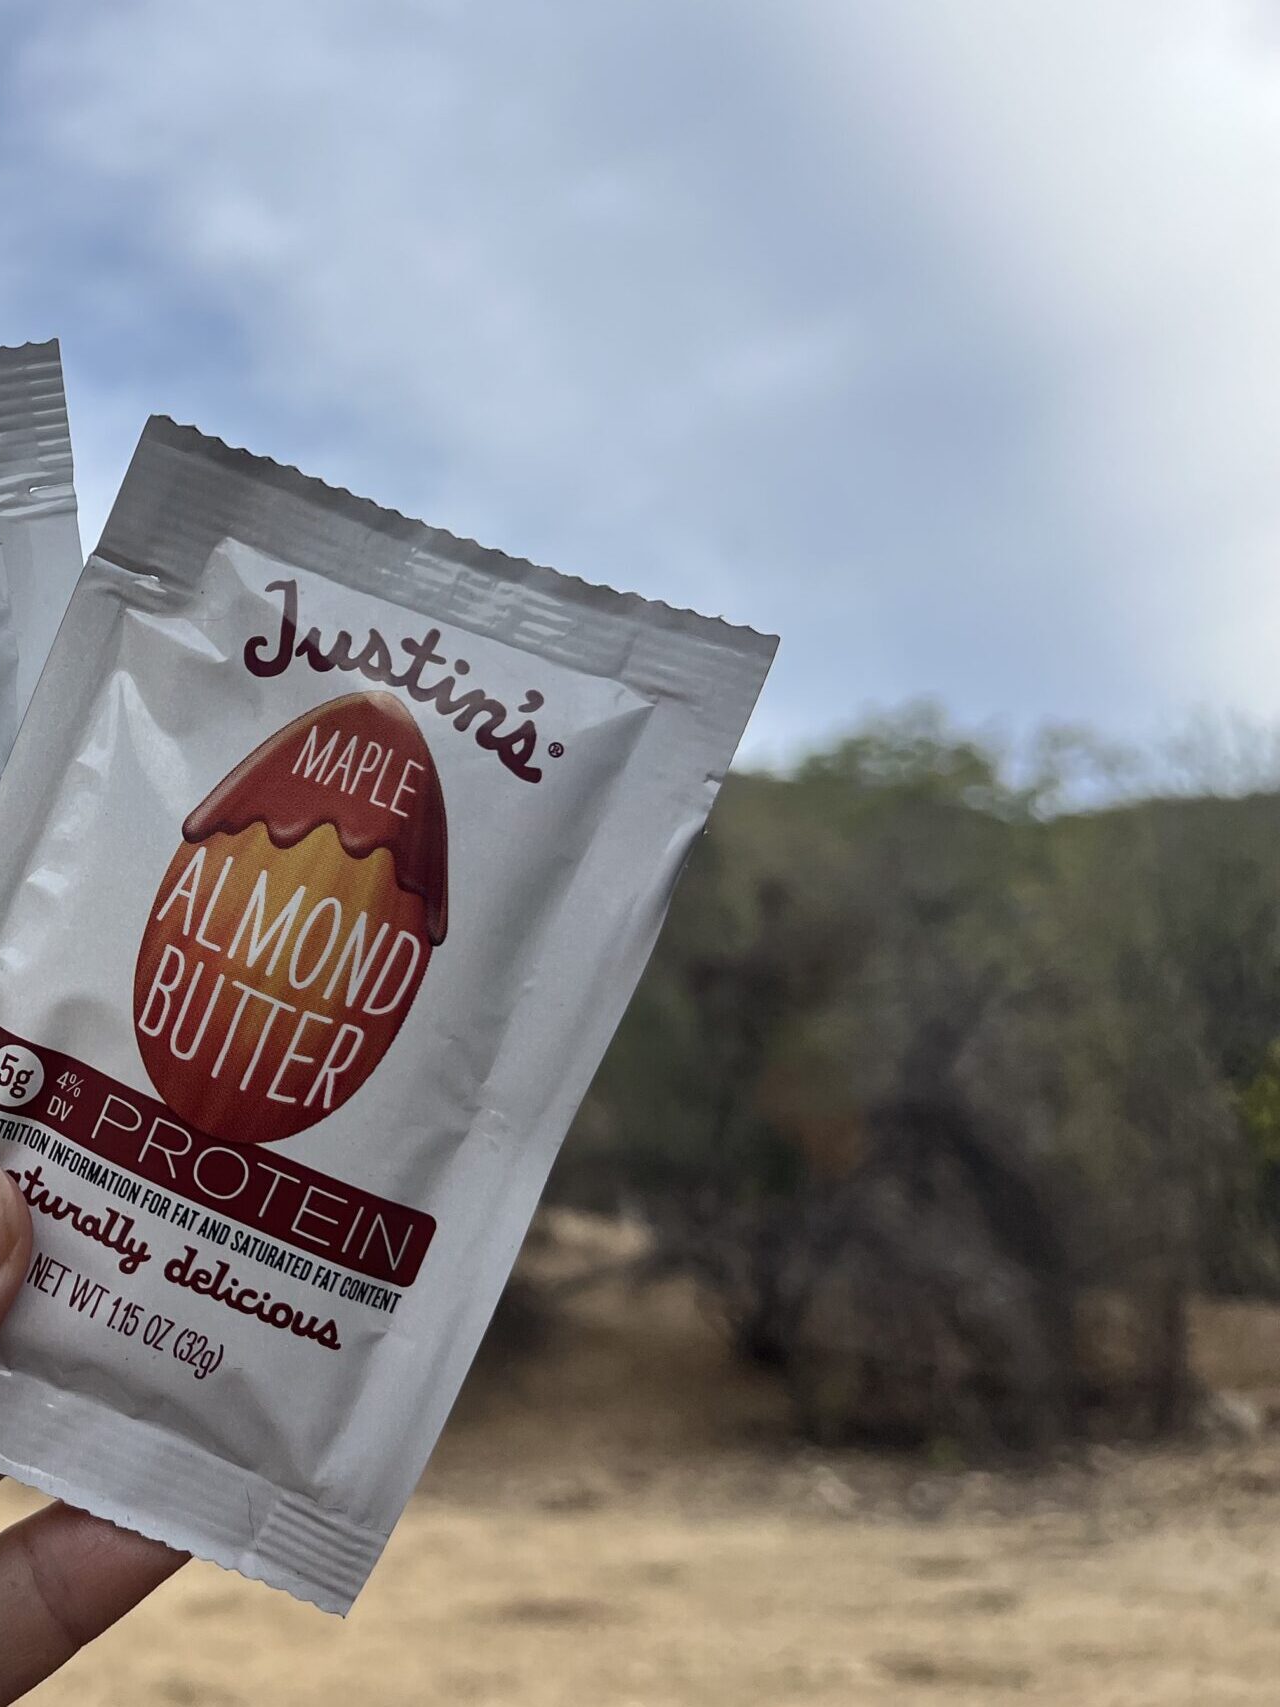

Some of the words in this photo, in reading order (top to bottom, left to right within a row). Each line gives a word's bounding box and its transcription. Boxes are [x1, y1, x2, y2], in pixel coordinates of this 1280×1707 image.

[292, 725, 425, 817] MAPLE
[156, 846, 421, 1015] ALMOND
[56, 1071, 84, 1098] 4%
[138, 944, 365, 1109] BUTTER
[46, 1095, 74, 1122] DV
[47, 1139, 143, 1205] INFORMATION
[139, 1188, 172, 1220] FOR
[170, 1202, 201, 1232] FAT
[196, 1216, 232, 1246] AND
[230, 1230, 314, 1282] SATURATED
[311, 1265, 342, 1293] FAT
[339, 1276, 403, 1315] CONTENT
[91, 1094, 414, 1272] PROTEIN
[26, 1252, 72, 1298] NET
[69, 1273, 111, 1319] WT
[106, 1296, 145, 1337] 1.15
[143, 1313, 176, 1352] OZ
[173, 1327, 225, 1380] (32g)
[163, 1244, 342, 1351] delicious
